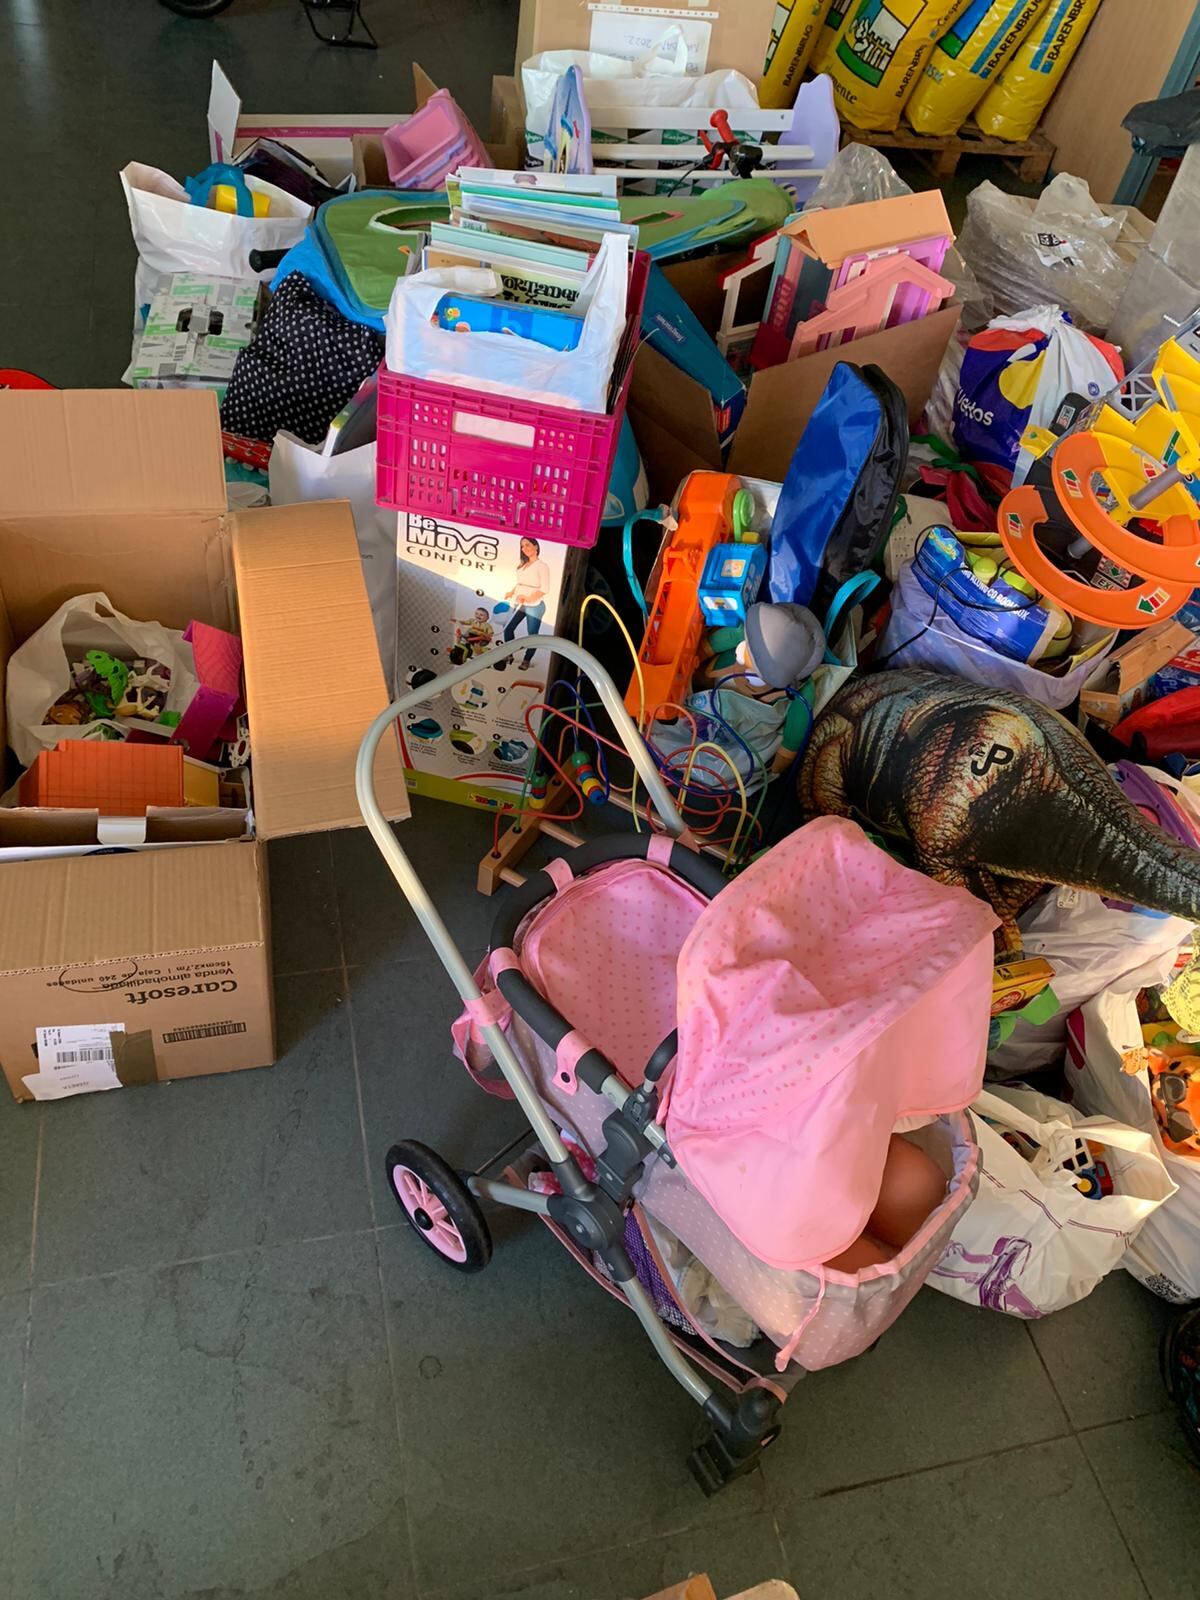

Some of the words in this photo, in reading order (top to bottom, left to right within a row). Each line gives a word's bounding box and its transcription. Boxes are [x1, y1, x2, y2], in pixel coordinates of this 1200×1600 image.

[782, 25, 813, 87] BARENBRUG
[406, 545, 497, 572] CONFORT
[971, 743, 1014, 776] JP
[46, 976, 94, 987] unidades
[99, 974, 117, 982] 240
[102, 971, 191, 989] almohadillada
[195, 967, 234, 978] Venda
[124, 980, 238, 1004] Caresoft
